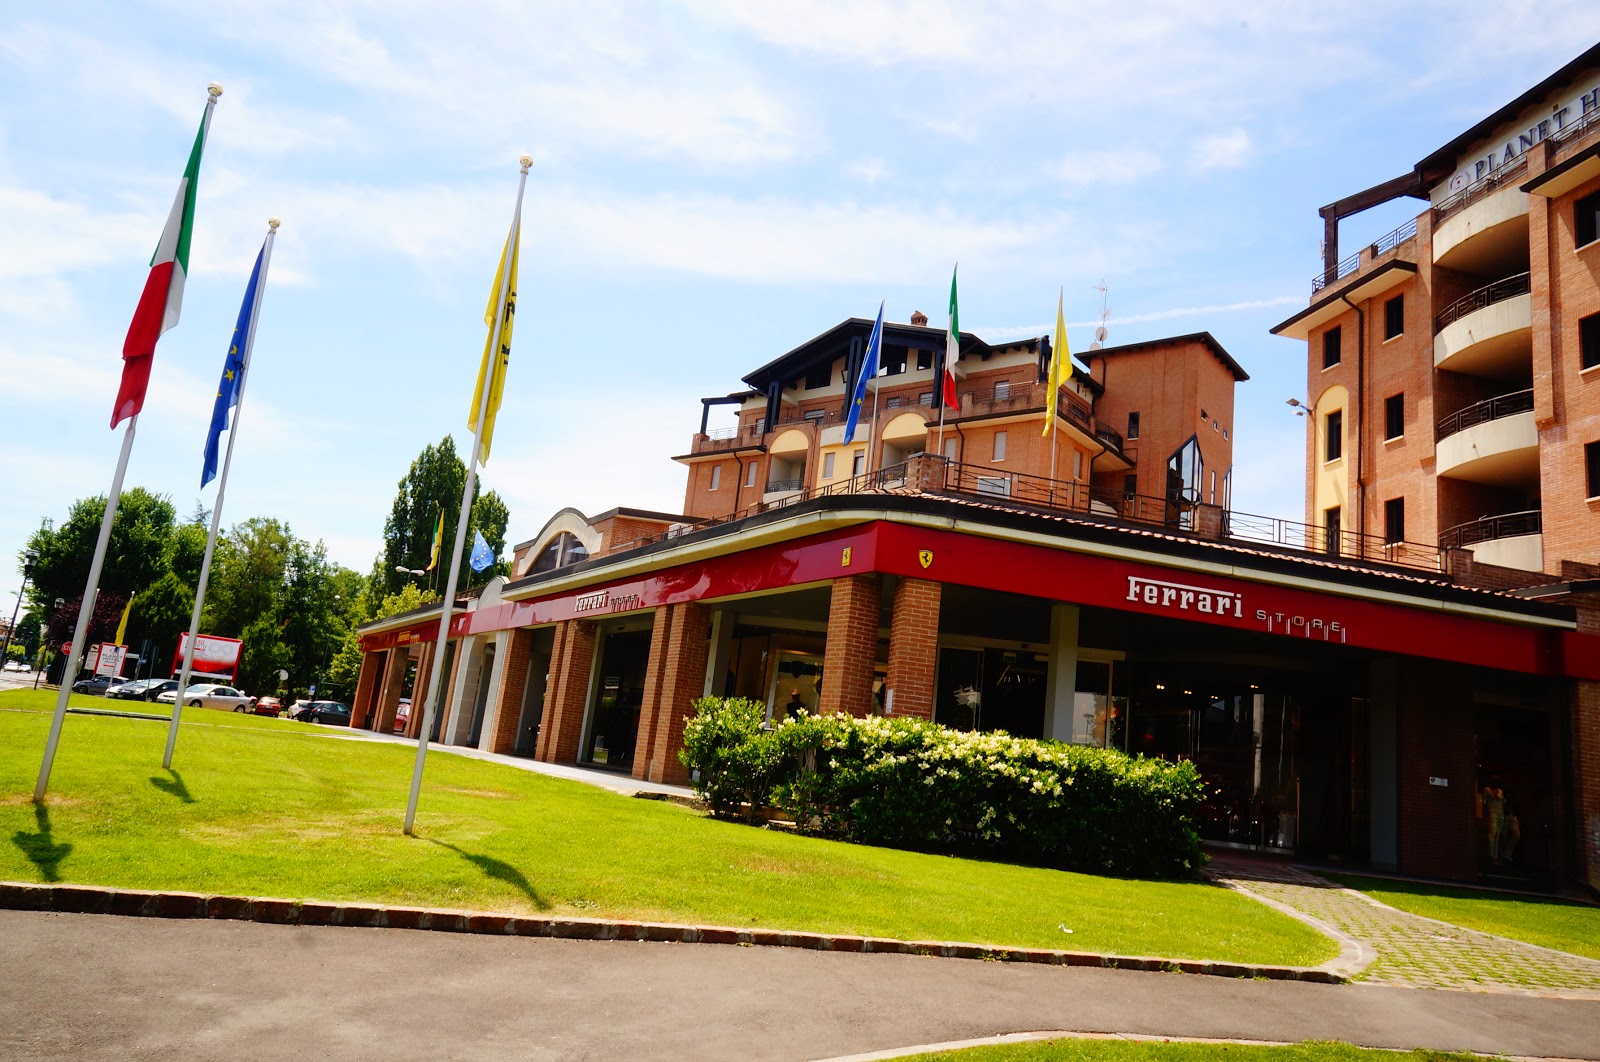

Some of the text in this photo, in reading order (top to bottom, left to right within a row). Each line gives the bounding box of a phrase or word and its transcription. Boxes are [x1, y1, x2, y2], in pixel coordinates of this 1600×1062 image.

[1475, 106, 1568, 180] PLANET
[574, 590, 607, 611] Ferrari
[1126, 576, 1341, 632] Ferrari STORE
